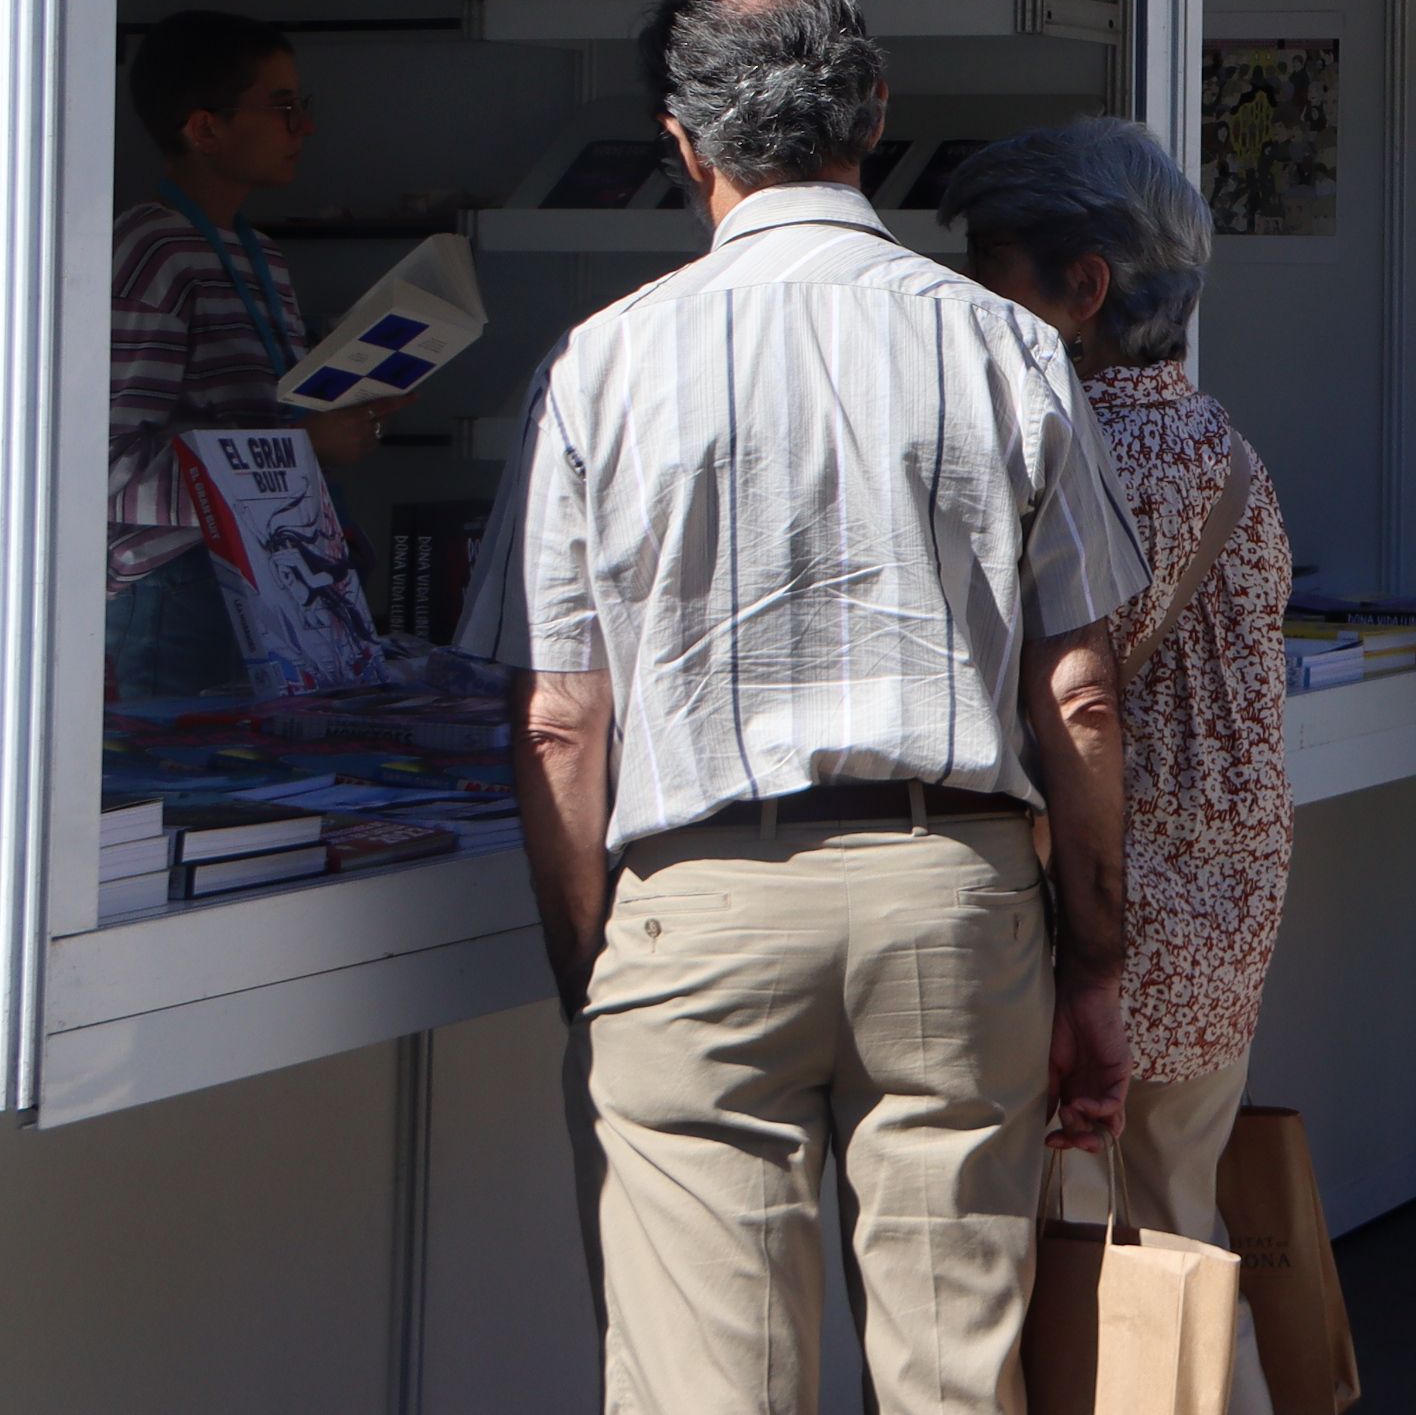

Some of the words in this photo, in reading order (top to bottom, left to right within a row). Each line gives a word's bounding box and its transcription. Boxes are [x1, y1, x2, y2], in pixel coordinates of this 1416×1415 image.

[218, 438, 249, 470] EL
[248, 437, 296, 468] GRAN
[252, 470, 289, 494] BUIT
